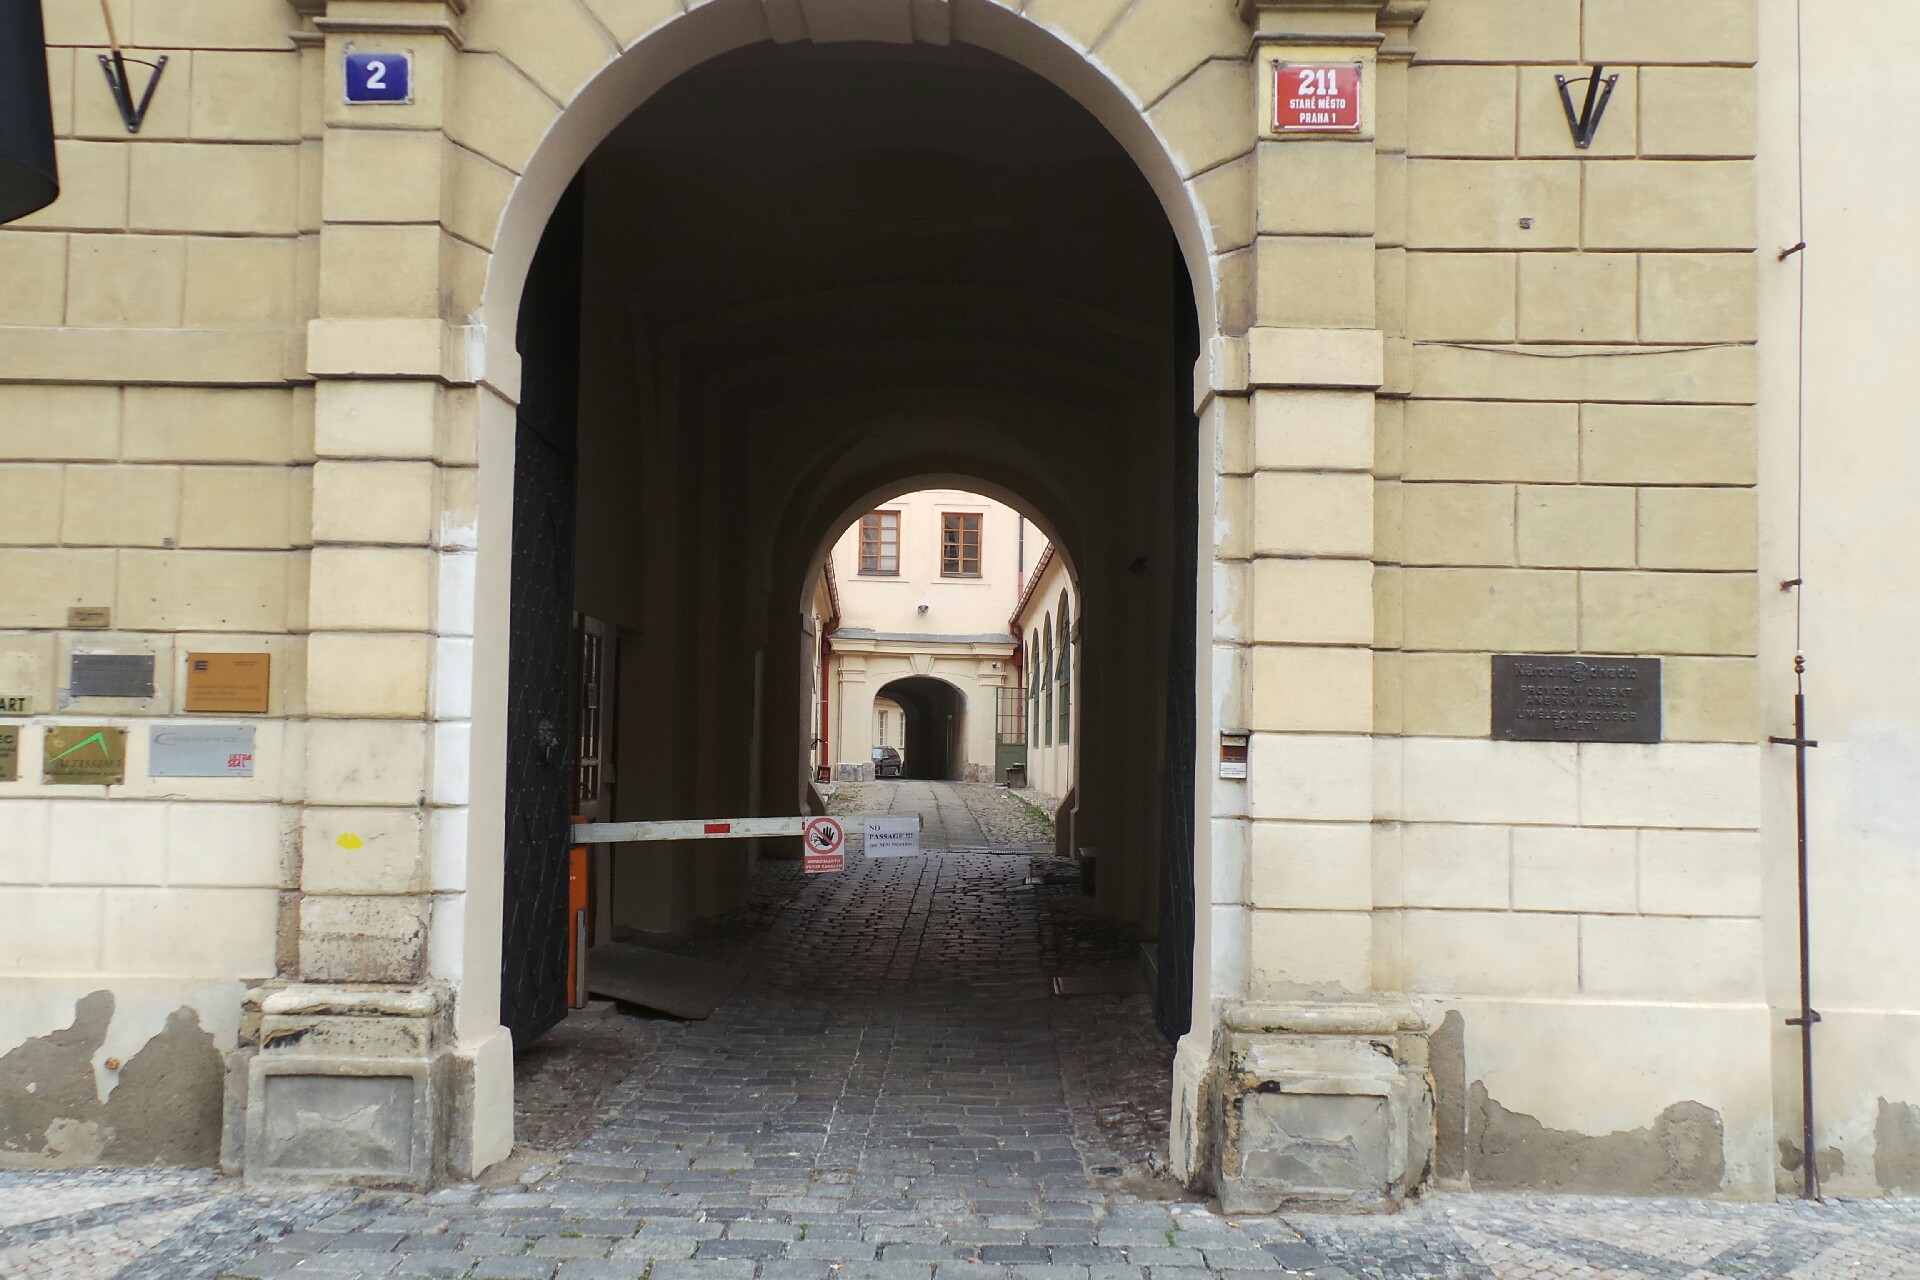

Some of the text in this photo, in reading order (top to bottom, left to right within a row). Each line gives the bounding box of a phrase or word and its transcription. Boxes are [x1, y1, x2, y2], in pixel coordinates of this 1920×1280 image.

[366, 60, 386, 89] 2
[1298, 69, 1338, 95] 211
[1289, 96, 1346, 109] STARÉ MĚSTO
[1299, 112, 1336, 123] PRAHA 1
[1589, 664, 1638, 680] divadlo
[1586, 686, 1633, 697] OBJEKT
[1586, 710, 1637, 721] SOUBOR
[1553, 719, 1600, 730] BALETU
